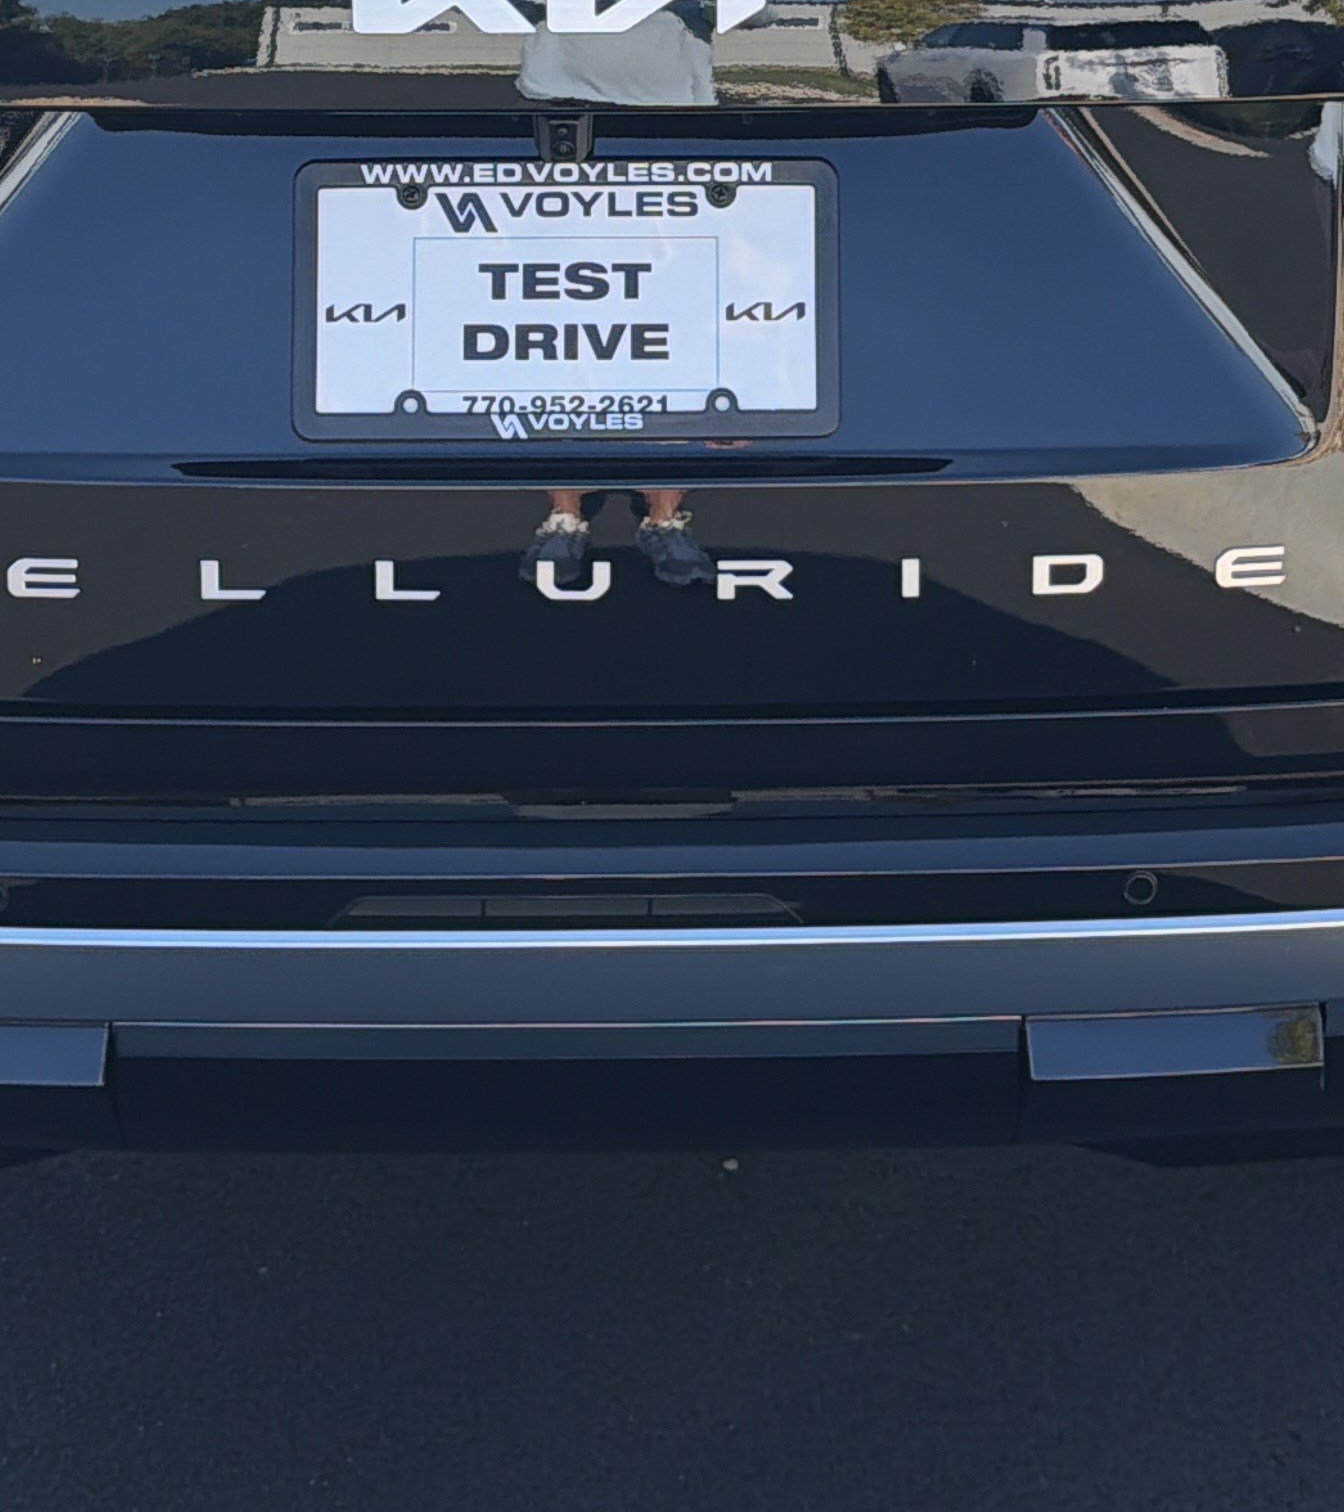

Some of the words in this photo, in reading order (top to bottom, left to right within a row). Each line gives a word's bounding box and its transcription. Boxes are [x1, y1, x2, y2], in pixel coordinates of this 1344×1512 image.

[501, 191, 699, 217] VOYLES
[478, 263, 653, 300] TEST
[463, 323, 670, 360] DRIVE
[462, 395, 669, 413] 770-952-2621
[528, 413, 644, 430] VOYLES
